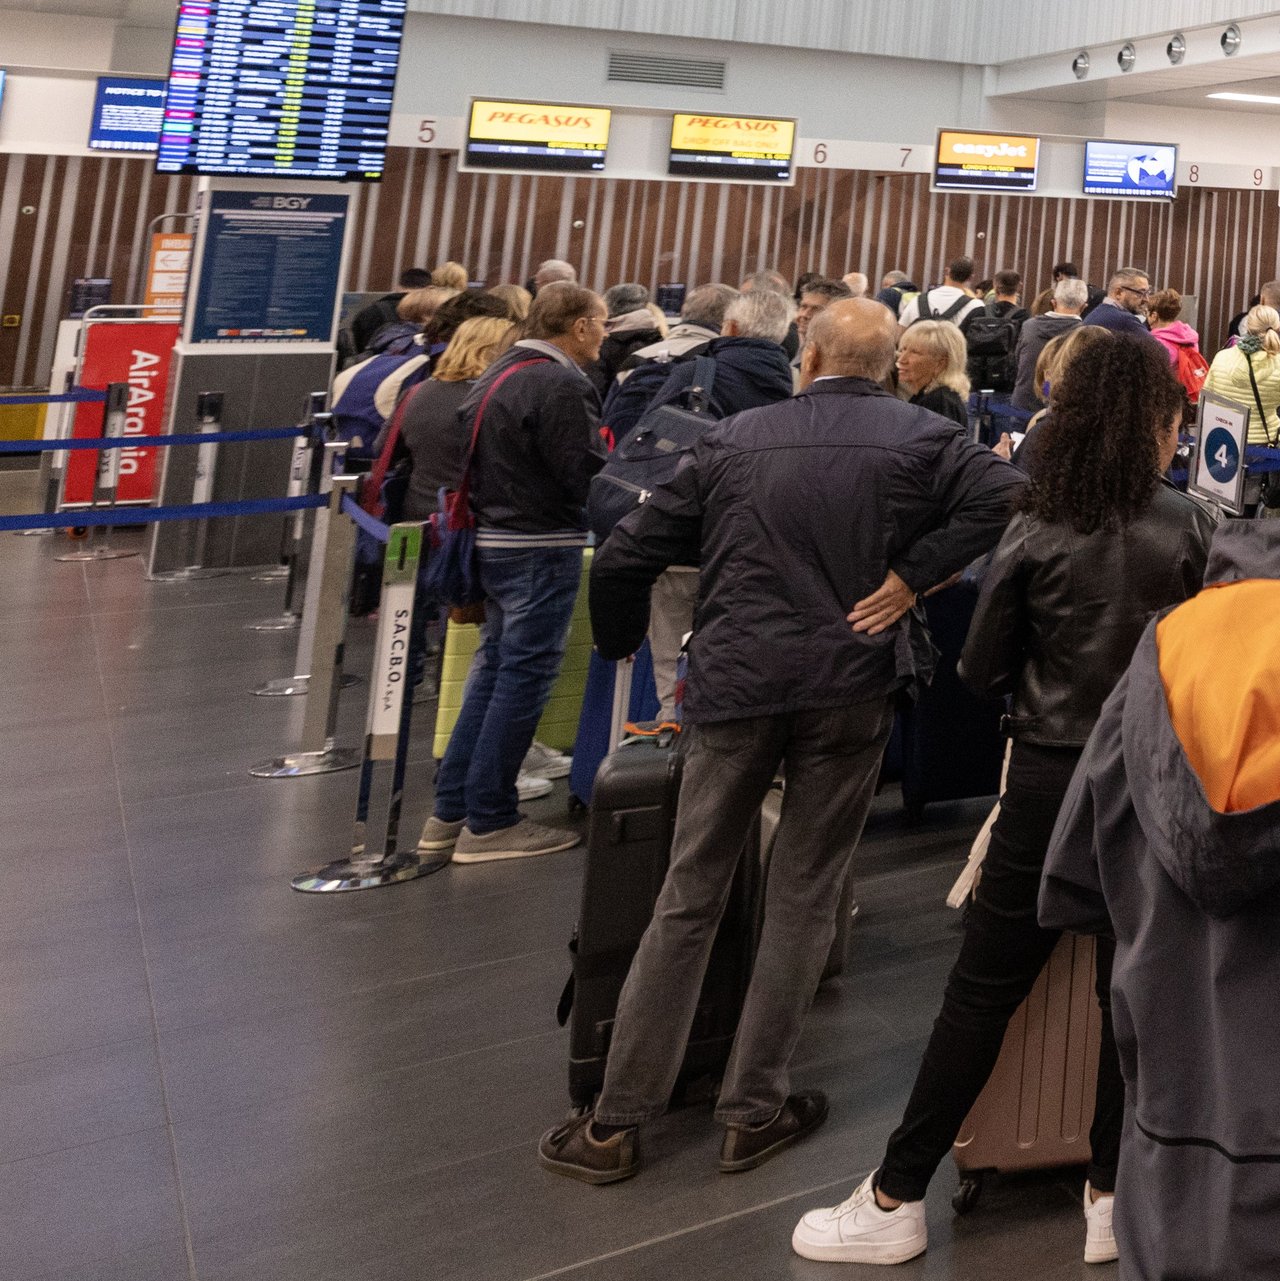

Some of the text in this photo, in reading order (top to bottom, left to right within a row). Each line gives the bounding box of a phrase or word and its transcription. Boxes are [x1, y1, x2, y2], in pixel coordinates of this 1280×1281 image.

[487, 111, 592, 130] PEGASUS
[686, 116, 780, 134] PEGASUS
[418, 120, 435, 142] 5
[813, 143, 827, 164] 6
[900, 148, 913, 168] 7
[952, 141, 1028, 160] easyJet
[1188, 165, 1200, 184] 8
[1253, 168, 1263, 186] 9
[272, 196, 312, 209] BGY
[1215, 416, 1233, 426] CHECK-IN
[1214, 443, 1228, 468] 4
